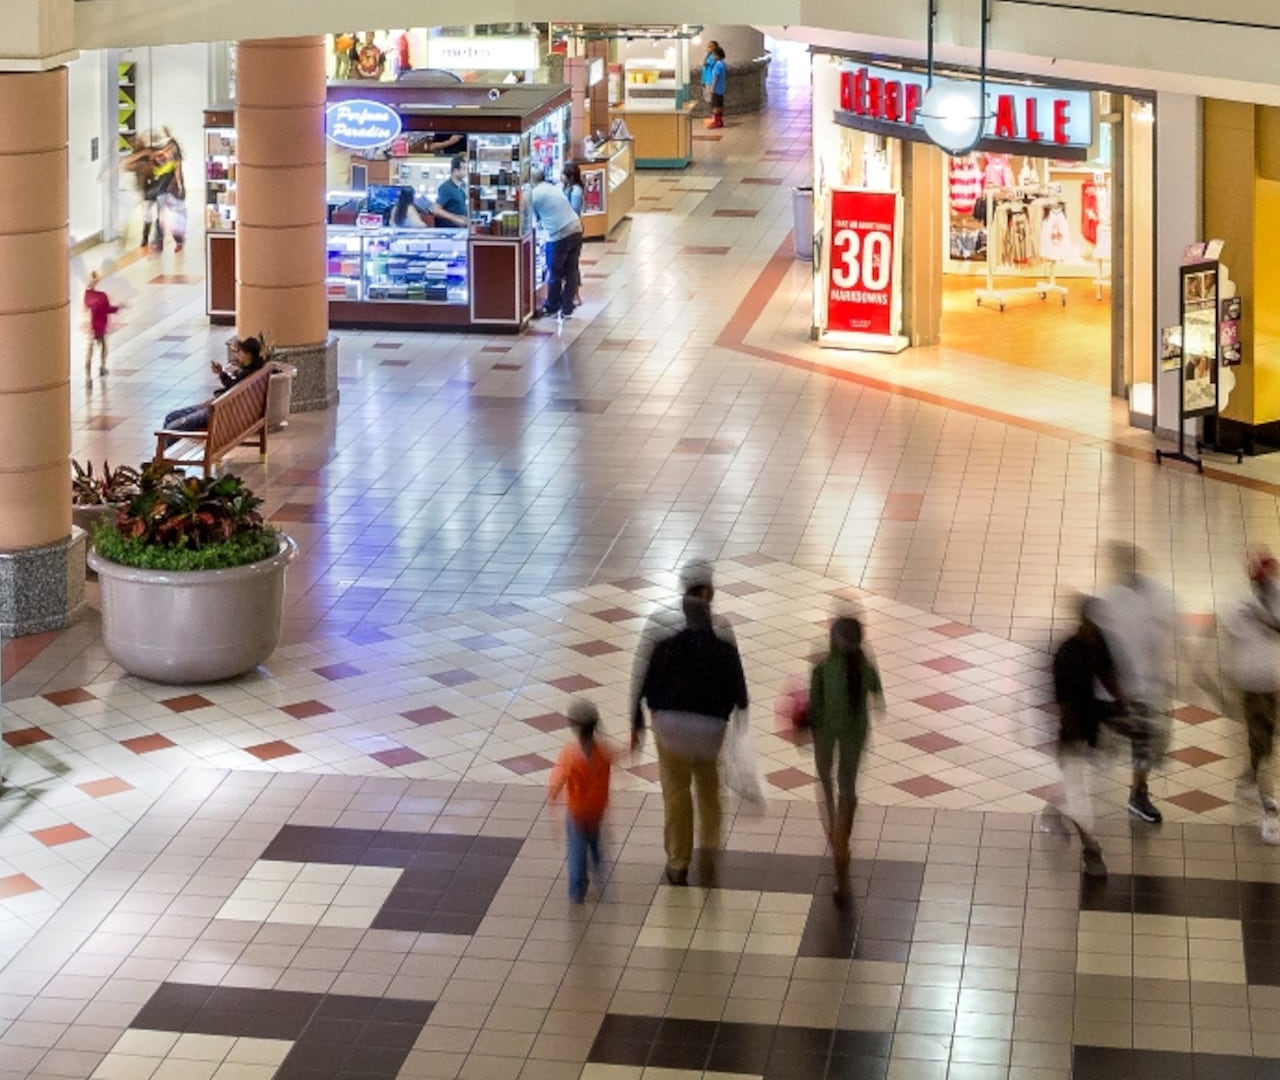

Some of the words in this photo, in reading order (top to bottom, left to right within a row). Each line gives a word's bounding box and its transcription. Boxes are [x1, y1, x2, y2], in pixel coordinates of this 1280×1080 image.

[335, 106, 391, 124] Perfume
[840, 67, 1071, 146] AÉROPALE
[333, 123, 392, 140] Paradise
[831, 228, 892, 292] 30
